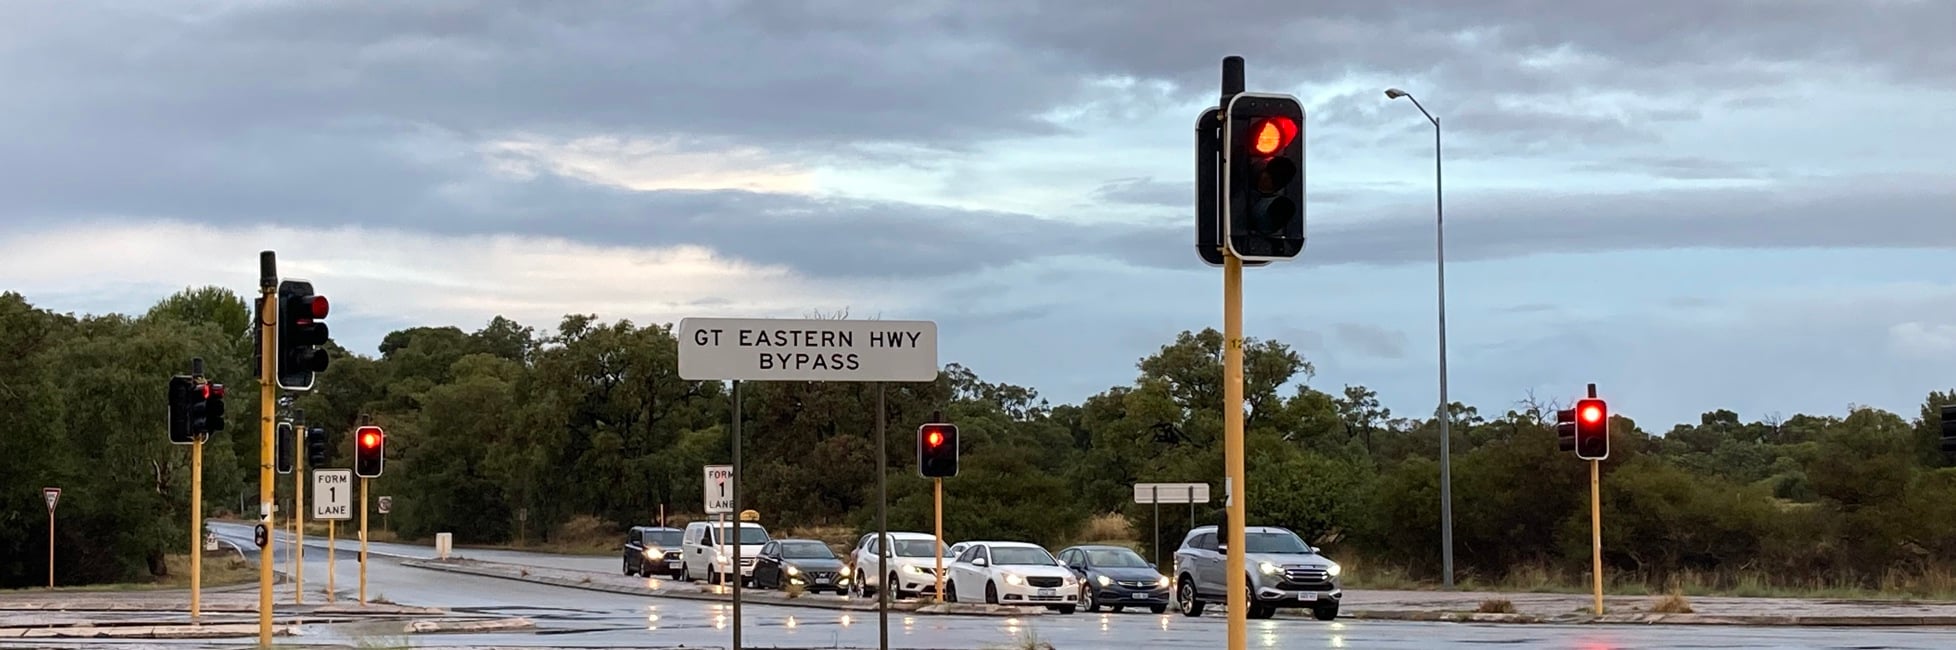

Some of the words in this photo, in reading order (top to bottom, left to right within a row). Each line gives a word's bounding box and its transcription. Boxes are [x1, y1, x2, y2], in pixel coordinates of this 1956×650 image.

[694, 329, 723, 346] GT
[739, 329, 853, 347] EASTERN
[870, 331, 921, 348] HWY
[759, 353, 860, 370] BYPASS
[318, 474, 346, 483] FORM
[329, 486, 335, 503] 1
[719, 482, 725, 498] 1
[318, 506, 346, 515] LANE
